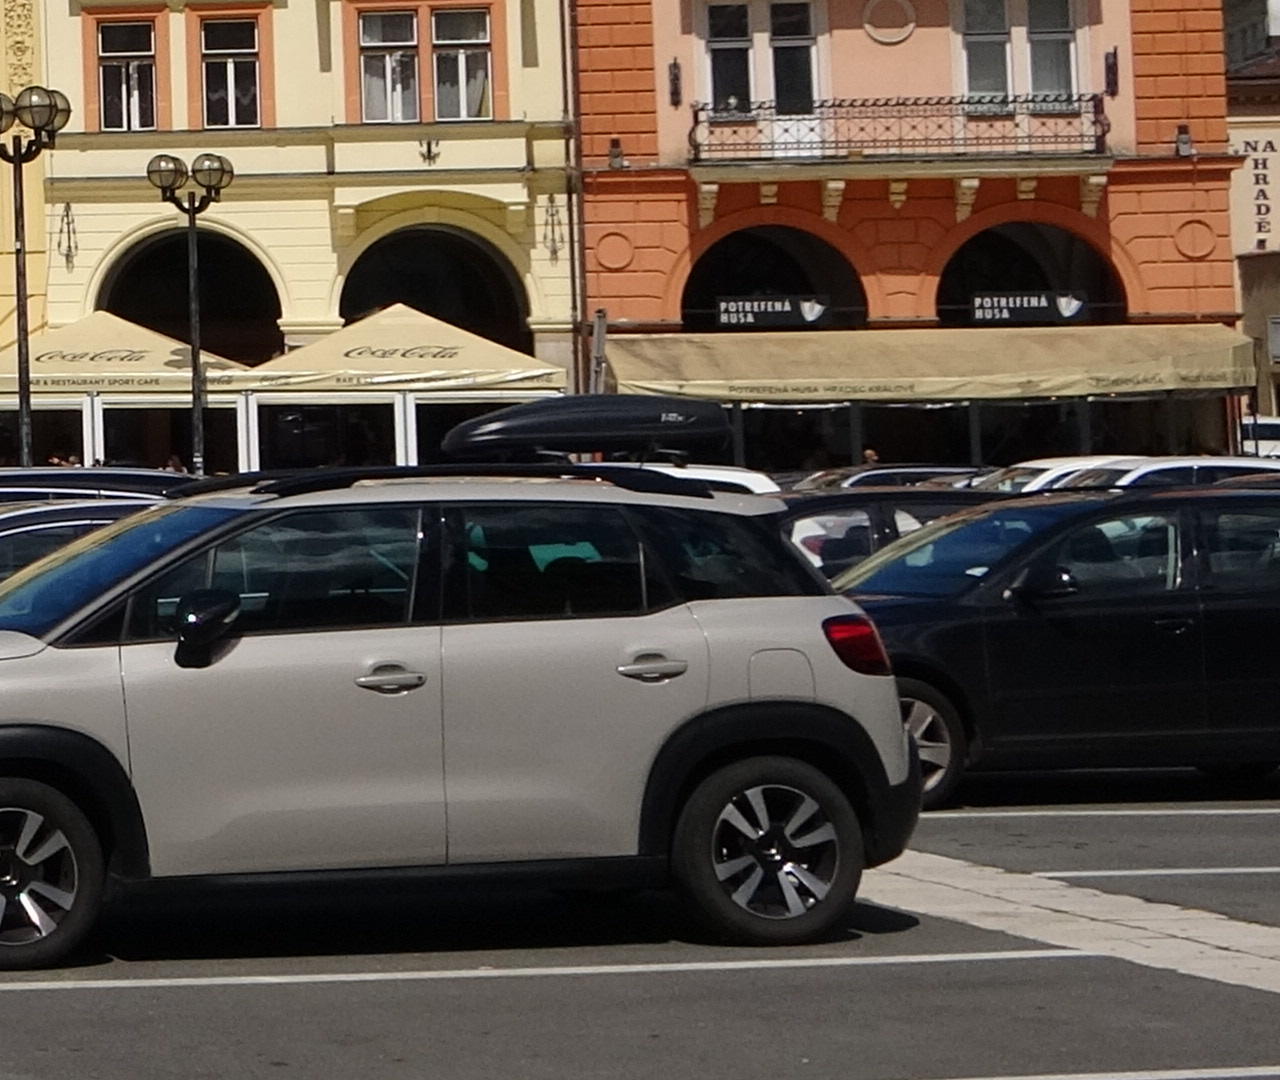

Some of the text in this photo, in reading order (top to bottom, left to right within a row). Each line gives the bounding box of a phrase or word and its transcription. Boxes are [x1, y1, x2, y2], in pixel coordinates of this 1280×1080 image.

[1243, 140, 1278, 153] NA
[720, 299, 792, 312] POTREFENÁ
[974, 294, 1049, 307] POTREFENÁ
[720, 312, 755, 323] HUSA
[975, 308, 1010, 319] HUSA
[108, 378, 134, 386] SPORT
